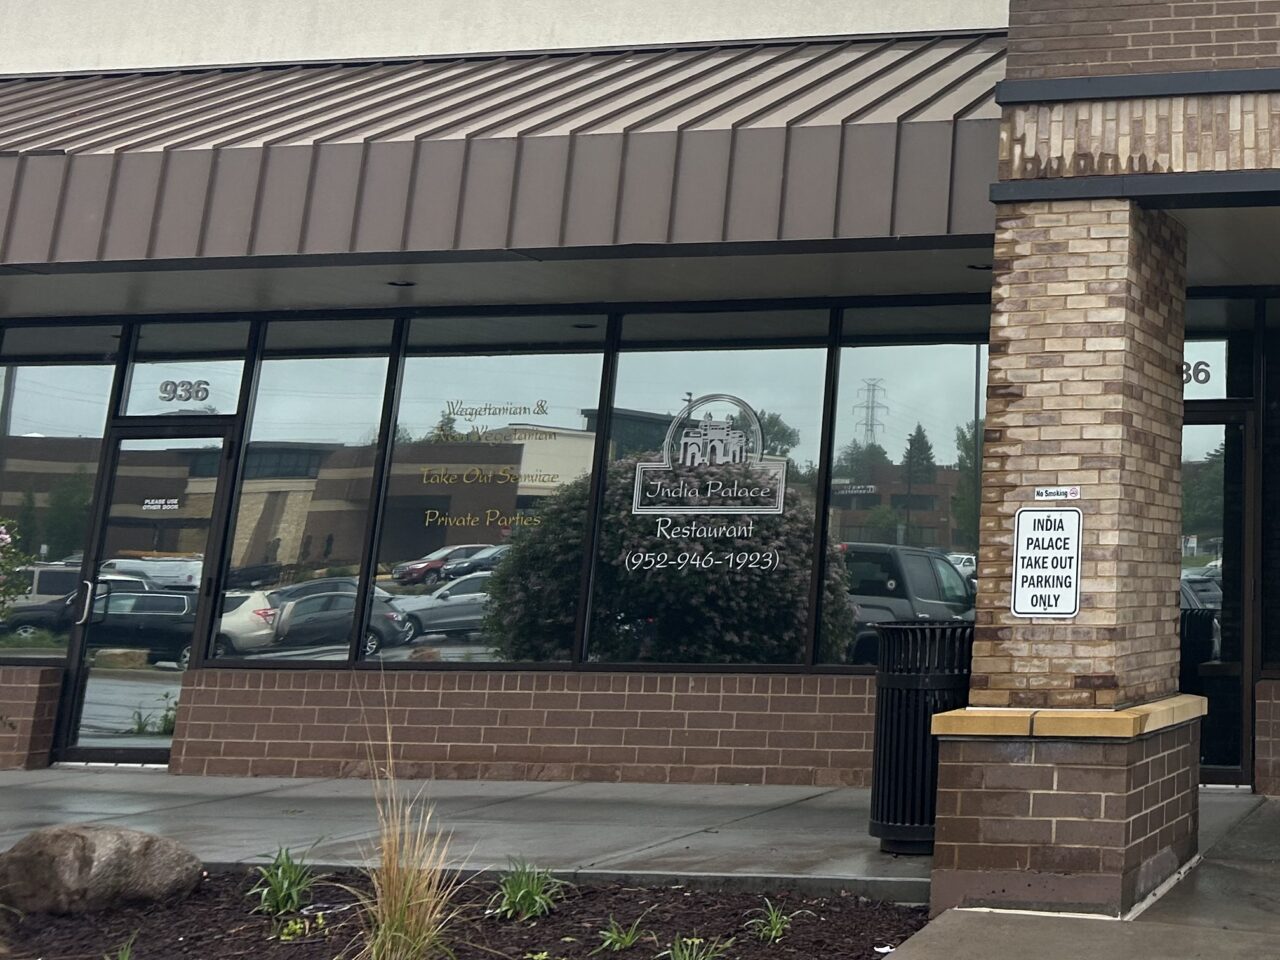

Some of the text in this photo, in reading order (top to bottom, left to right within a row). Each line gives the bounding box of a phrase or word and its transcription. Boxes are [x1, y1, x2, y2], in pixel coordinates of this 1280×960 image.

[158, 379, 210, 402] 936
[420, 467, 458, 484] Take
[463, 467, 493, 484] Out
[646, 480, 771, 498] India Palace
[1045, 489, 1068, 498] Smoking
[424, 509, 542, 527] Private Parties
[1032, 518, 1065, 532] INDIA
[655, 517, 755, 539] Restaurant
[1026, 537, 1070, 551] PALACE
[625, 549, 780, 572] (952-946-1923)
[1020, 556, 1074, 570] TAKE OUT
[1021, 575, 1072, 589] PARKING
[1030, 594, 1061, 608] ONLY
